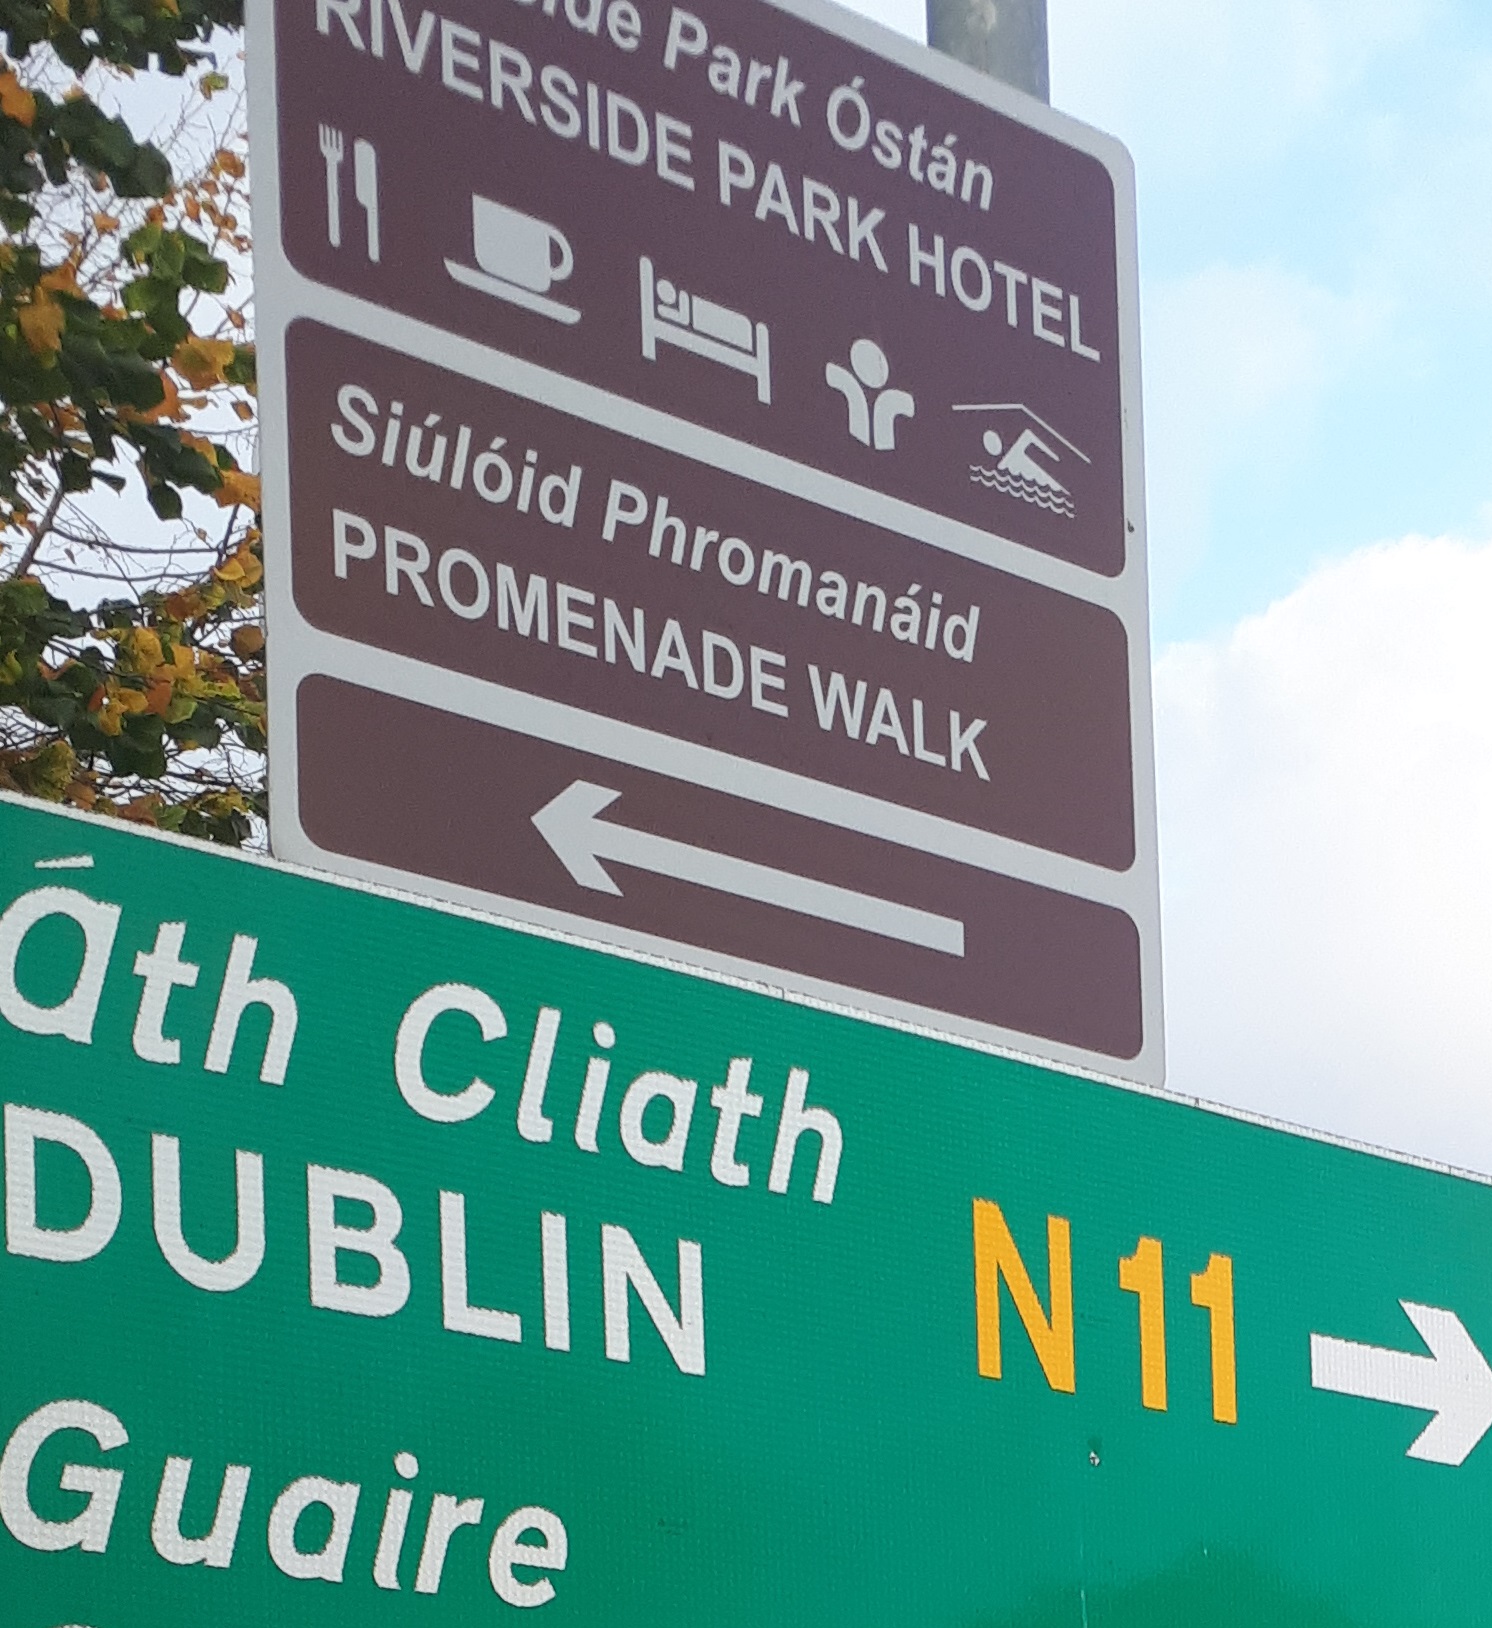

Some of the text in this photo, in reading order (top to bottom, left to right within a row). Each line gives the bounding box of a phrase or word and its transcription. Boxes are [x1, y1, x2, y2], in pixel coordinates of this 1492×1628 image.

[316, 0, 1101, 362] RIVERSIDE PARK HOTEL
[664, 8, 805, 126] Park
[827, 76, 994, 211] Óstán
[331, 384, 980, 664] Siúlóid Phromanáid
[333, 508, 991, 782] PROMENADE WALK
[394, 982, 843, 1204] Cliath
[4, 1103, 706, 1377] DUBLIN
[973, 1199, 1238, 1425] N 11
[0, 1400, 568, 1608] Guaire
